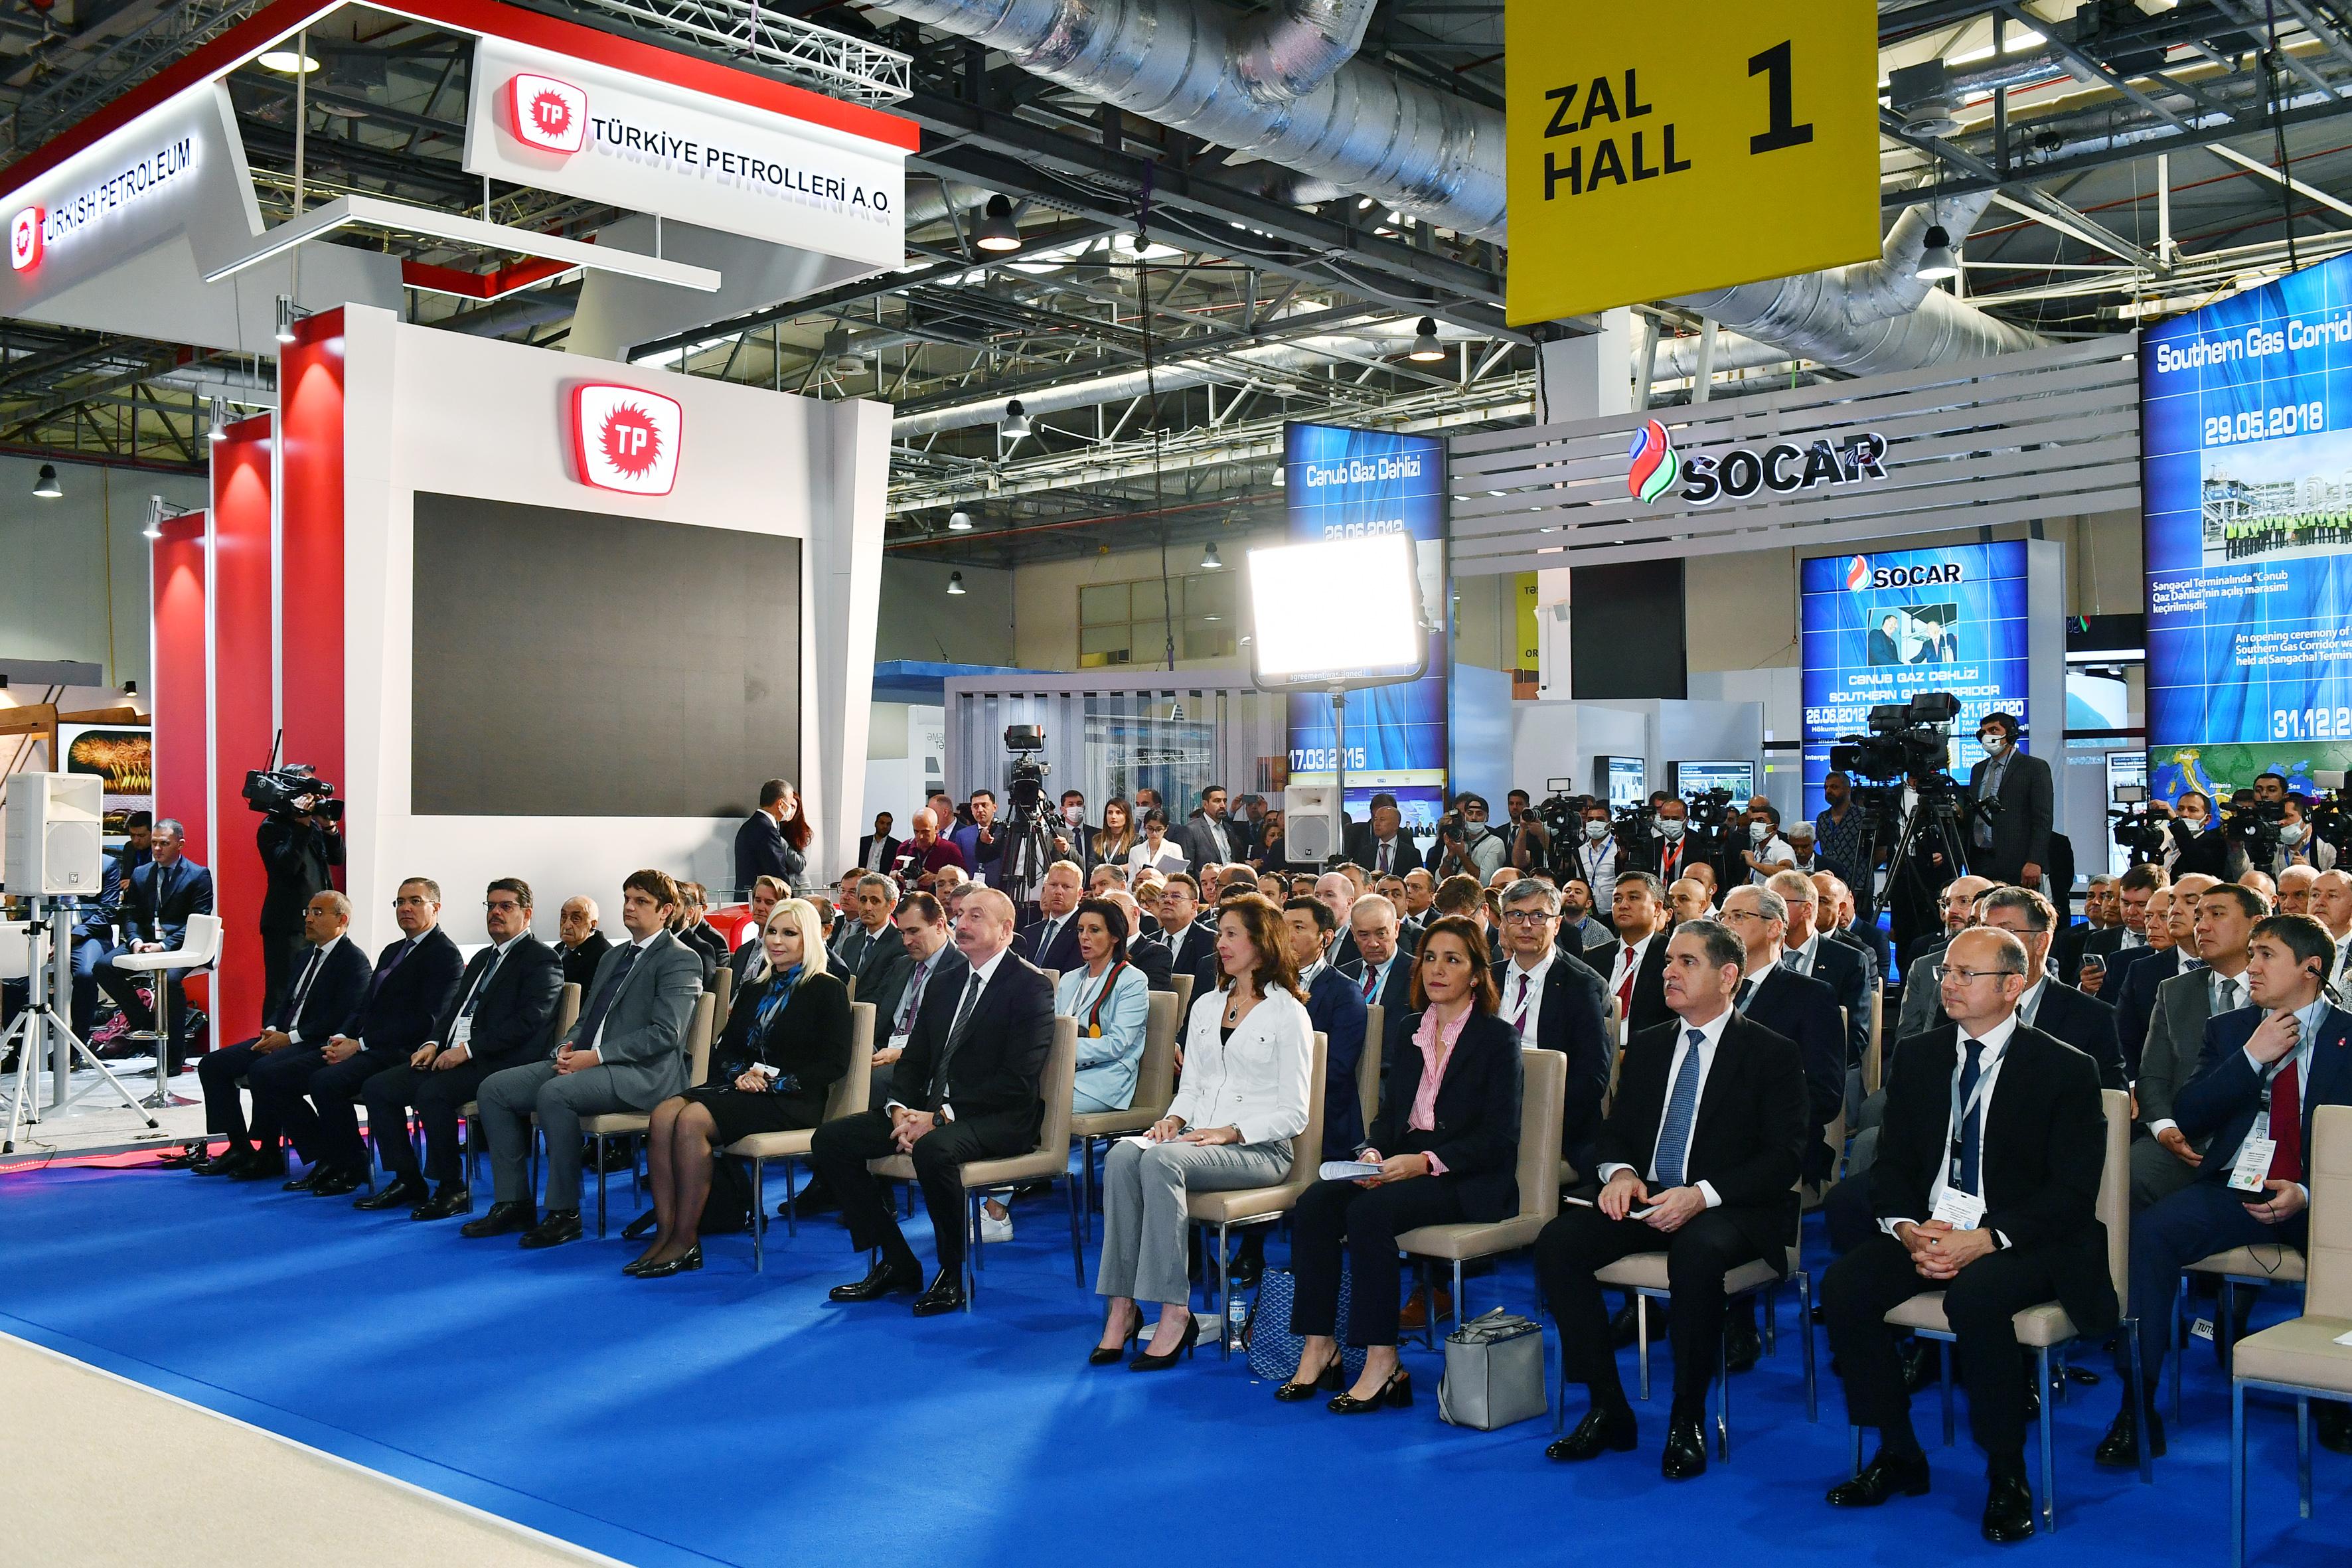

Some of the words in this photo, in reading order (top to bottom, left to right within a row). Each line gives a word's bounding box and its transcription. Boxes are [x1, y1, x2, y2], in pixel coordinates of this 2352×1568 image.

[539, 101, 563, 125] TP
[1545, 68, 1652, 138] ZAL
[1748, 39, 1813, 155] 1
[591, 118, 698, 163] TÜRKİYE
[707, 147, 846, 202] PETROLLERİ
[852, 187, 892, 214] A.O.
[1545, 123, 1691, 200] HALL
[40, 191, 96, 244] TURKISH
[100, 137, 190, 213] PETROLEUM
[2157, 337, 2243, 373] Southern
[2246, 327, 2285, 358] Gas
[2205, 401, 2323, 445] 29.05.2018
[615, 424, 648, 458] TP
[1350, 461, 1376, 483] Qaz
[1680, 433, 1887, 505] SOCAR
[1873, 562, 1964, 589] SOCAR
[2152, 593, 2170, 603] Qaz
[2236, 633, 2248, 643] An
[2250, 631, 2289, 646] opening
[2290, 628, 2337, 639] ceremony
[2339, 625, 2349, 636] of
[2236, 643, 2278, 655] Southern
[2280, 642, 2298, 652] Gas
[2299, 639, 2339, 651] Corridor
[2236, 655, 2256, 666] held
[2258, 655, 2268, 665] at
[2269, 651, 2317, 666] Sangachal
[1829, 690, 1897, 703] SOUTHERN
[1806, 707, 1866, 725] 26.06.2012
[2273, 706, 2352, 738] 31.12.2
